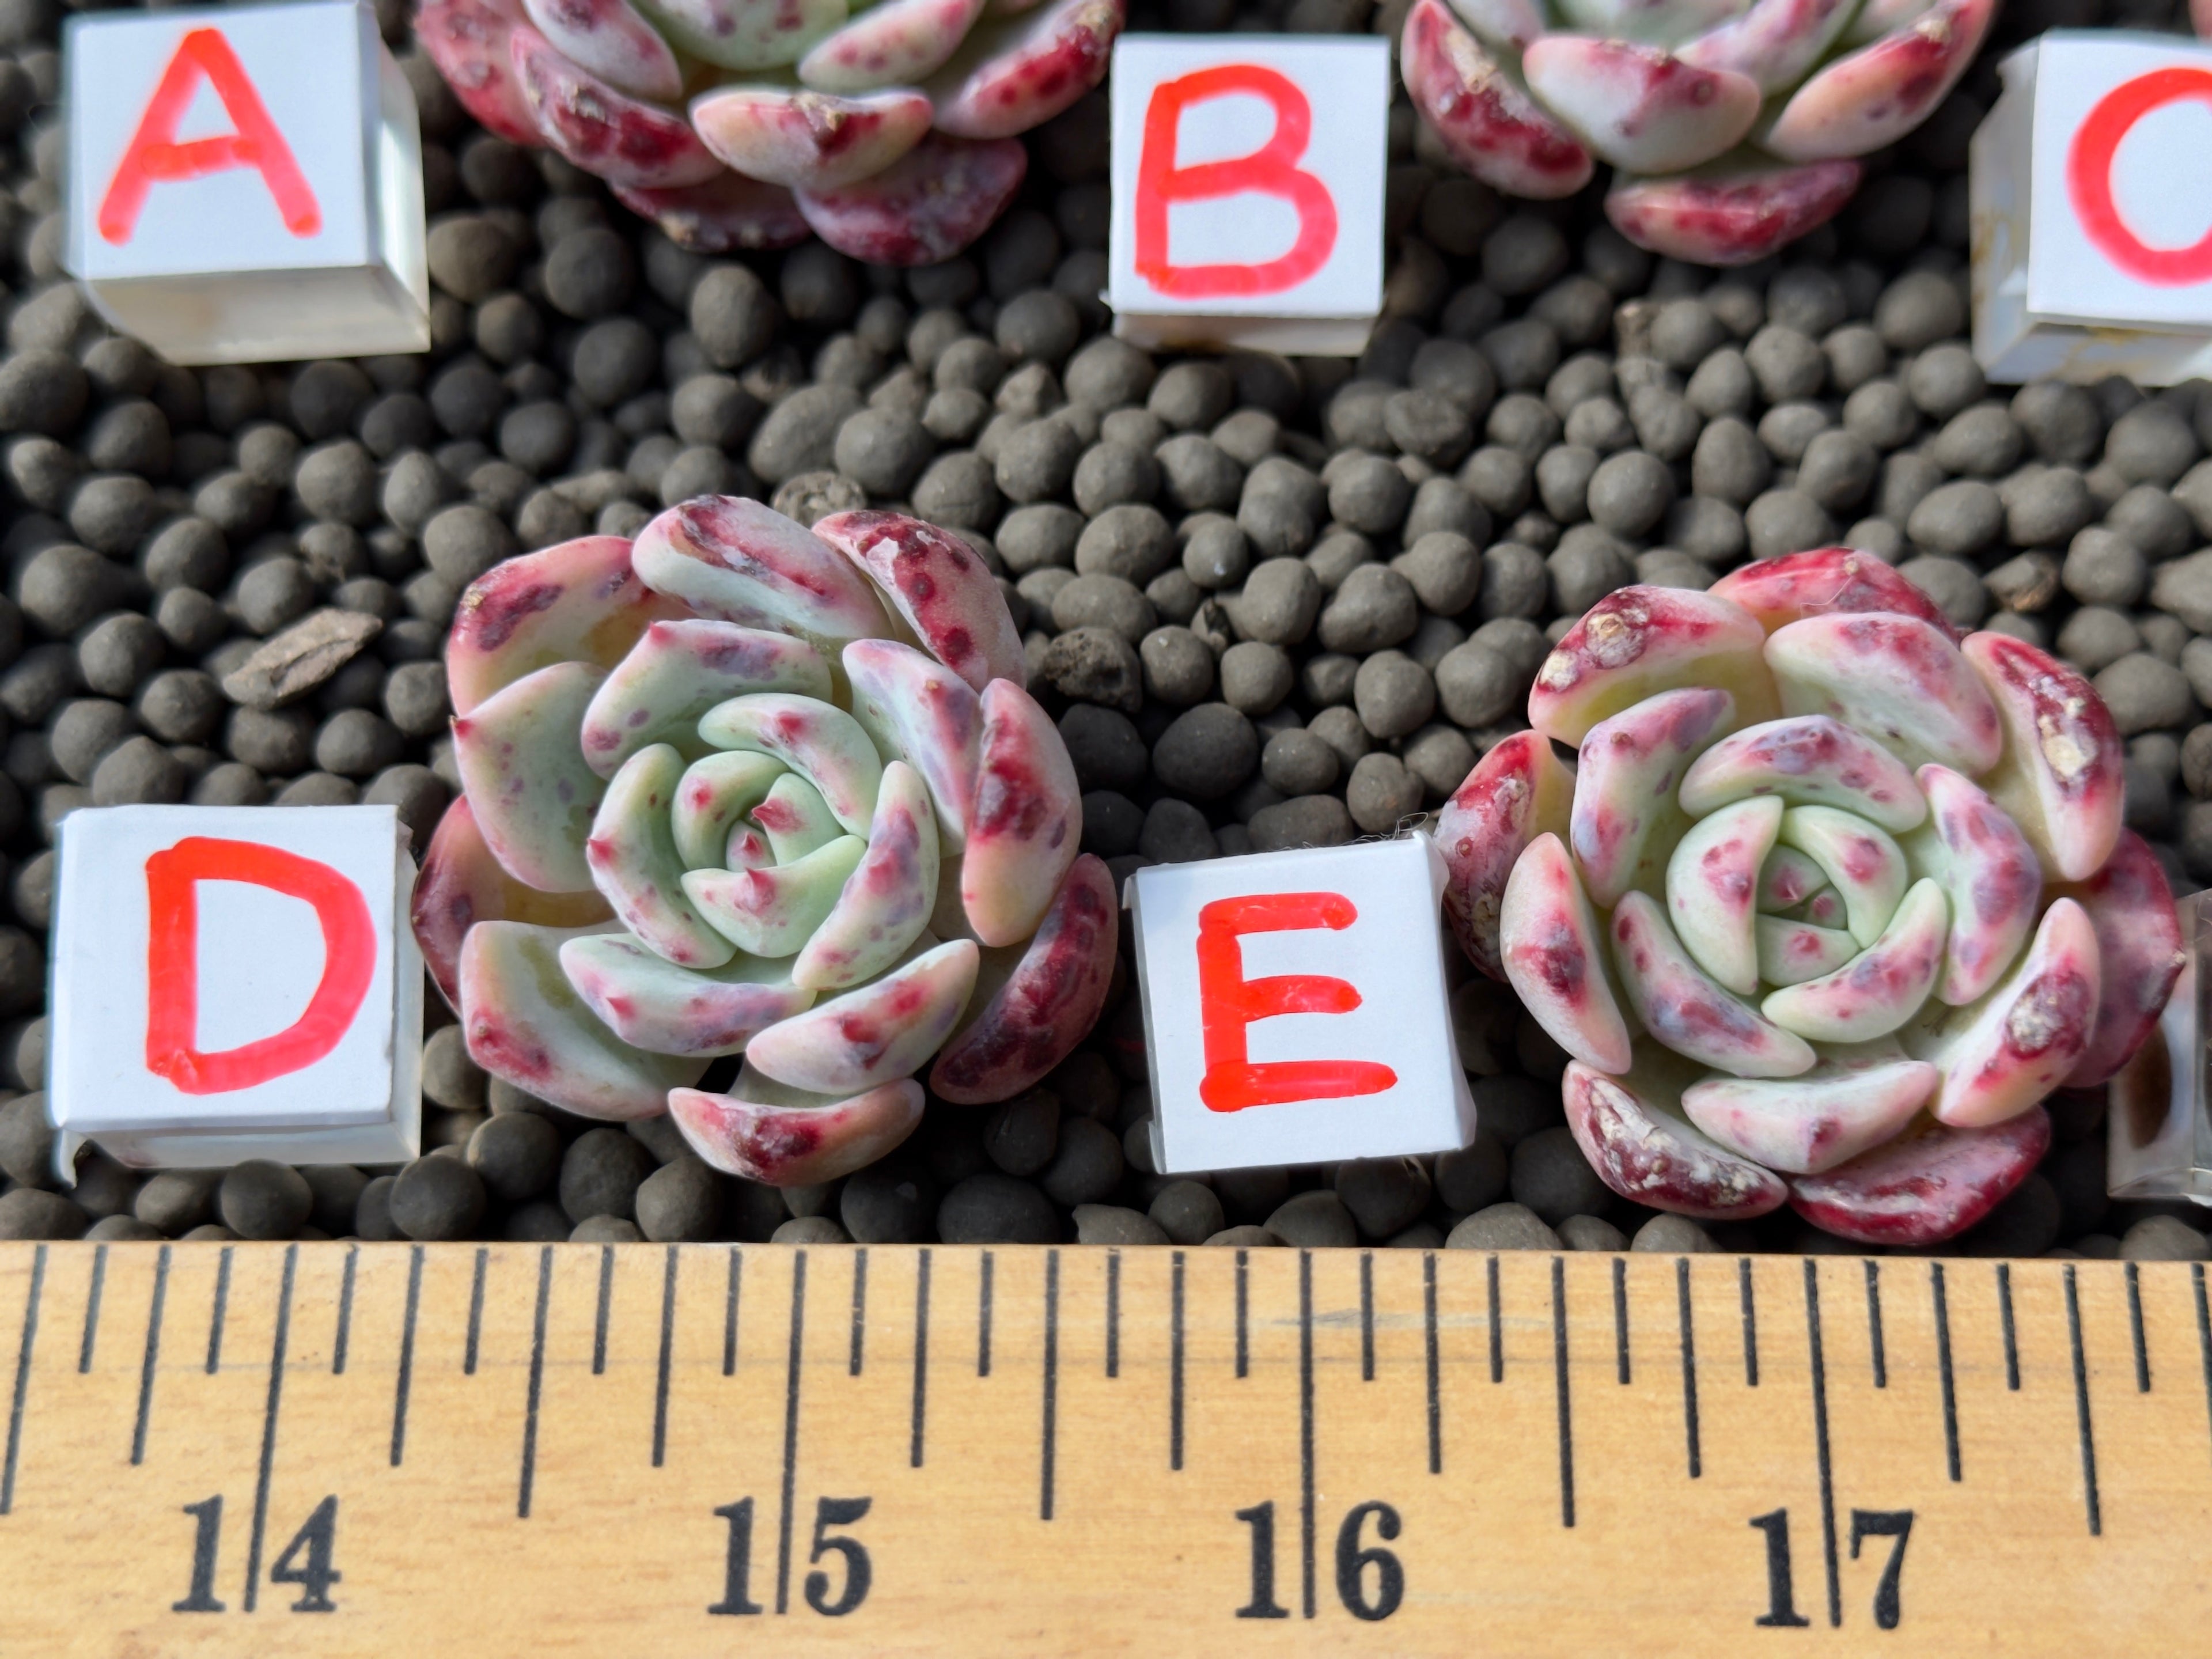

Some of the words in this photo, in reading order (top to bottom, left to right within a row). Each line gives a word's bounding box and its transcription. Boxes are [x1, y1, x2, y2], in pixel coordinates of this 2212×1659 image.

[97, 26, 321, 245] A
[1132, 62, 1339, 300] B
[143, 835, 377, 1096] D
[1195, 891, 1399, 1114] E
[172, 1495, 341, 1612] 14
[707, 1497, 872, 1616] 15
[1234, 1501, 1404, 1622] 16
[1750, 1508, 1914, 1630] 17
